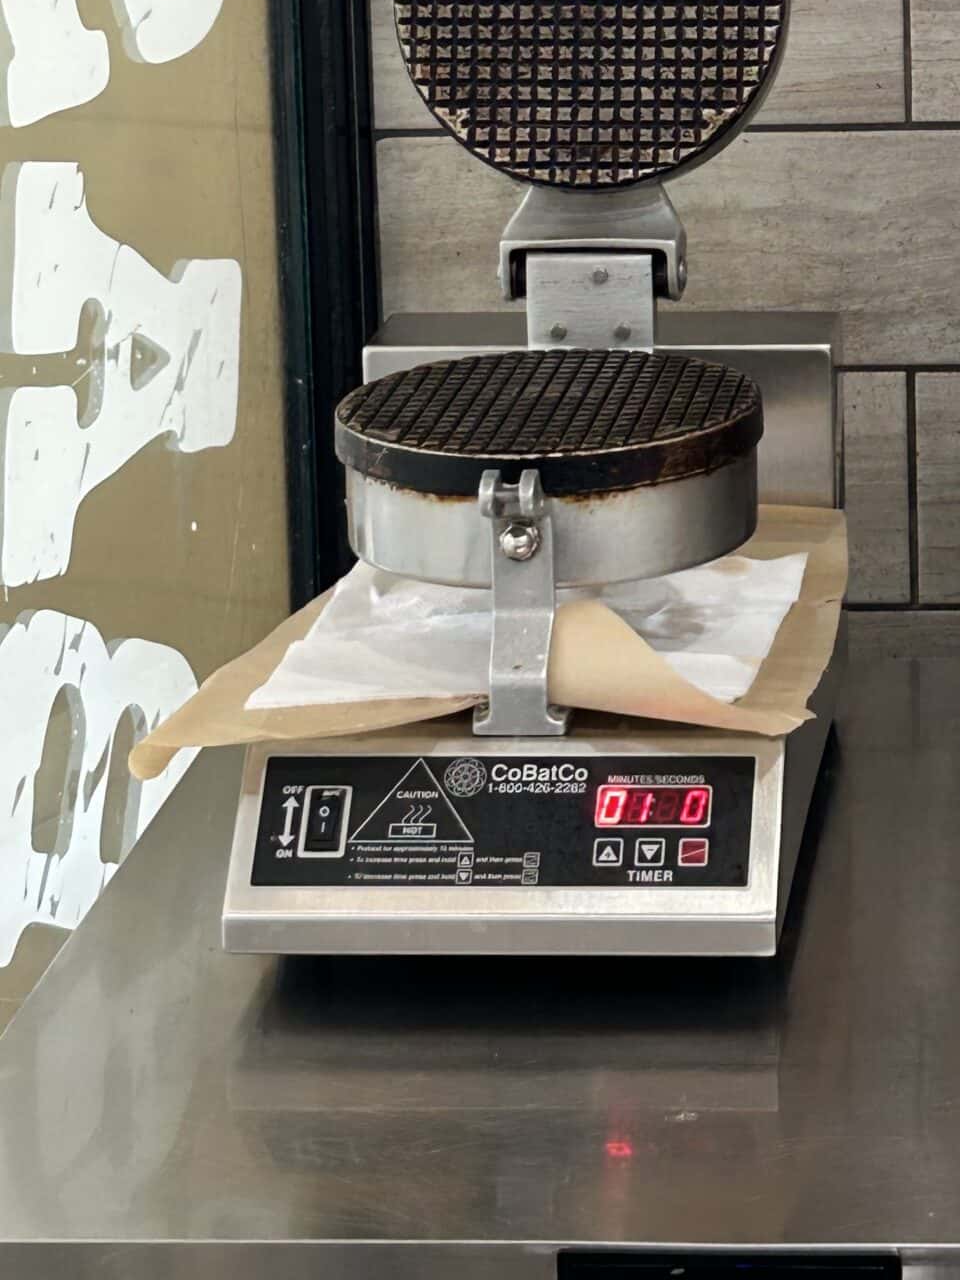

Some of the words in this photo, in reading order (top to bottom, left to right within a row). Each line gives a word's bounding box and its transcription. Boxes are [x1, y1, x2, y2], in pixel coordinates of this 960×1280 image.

[491, 764, 589, 782] CoBatCo
[282, 784, 305, 795] OFF
[396, 790, 439, 800] CAUTION
[402, 825, 423, 835] HOT
[275, 849, 293, 859] ON
[627, 870, 673, 883] TIMER
